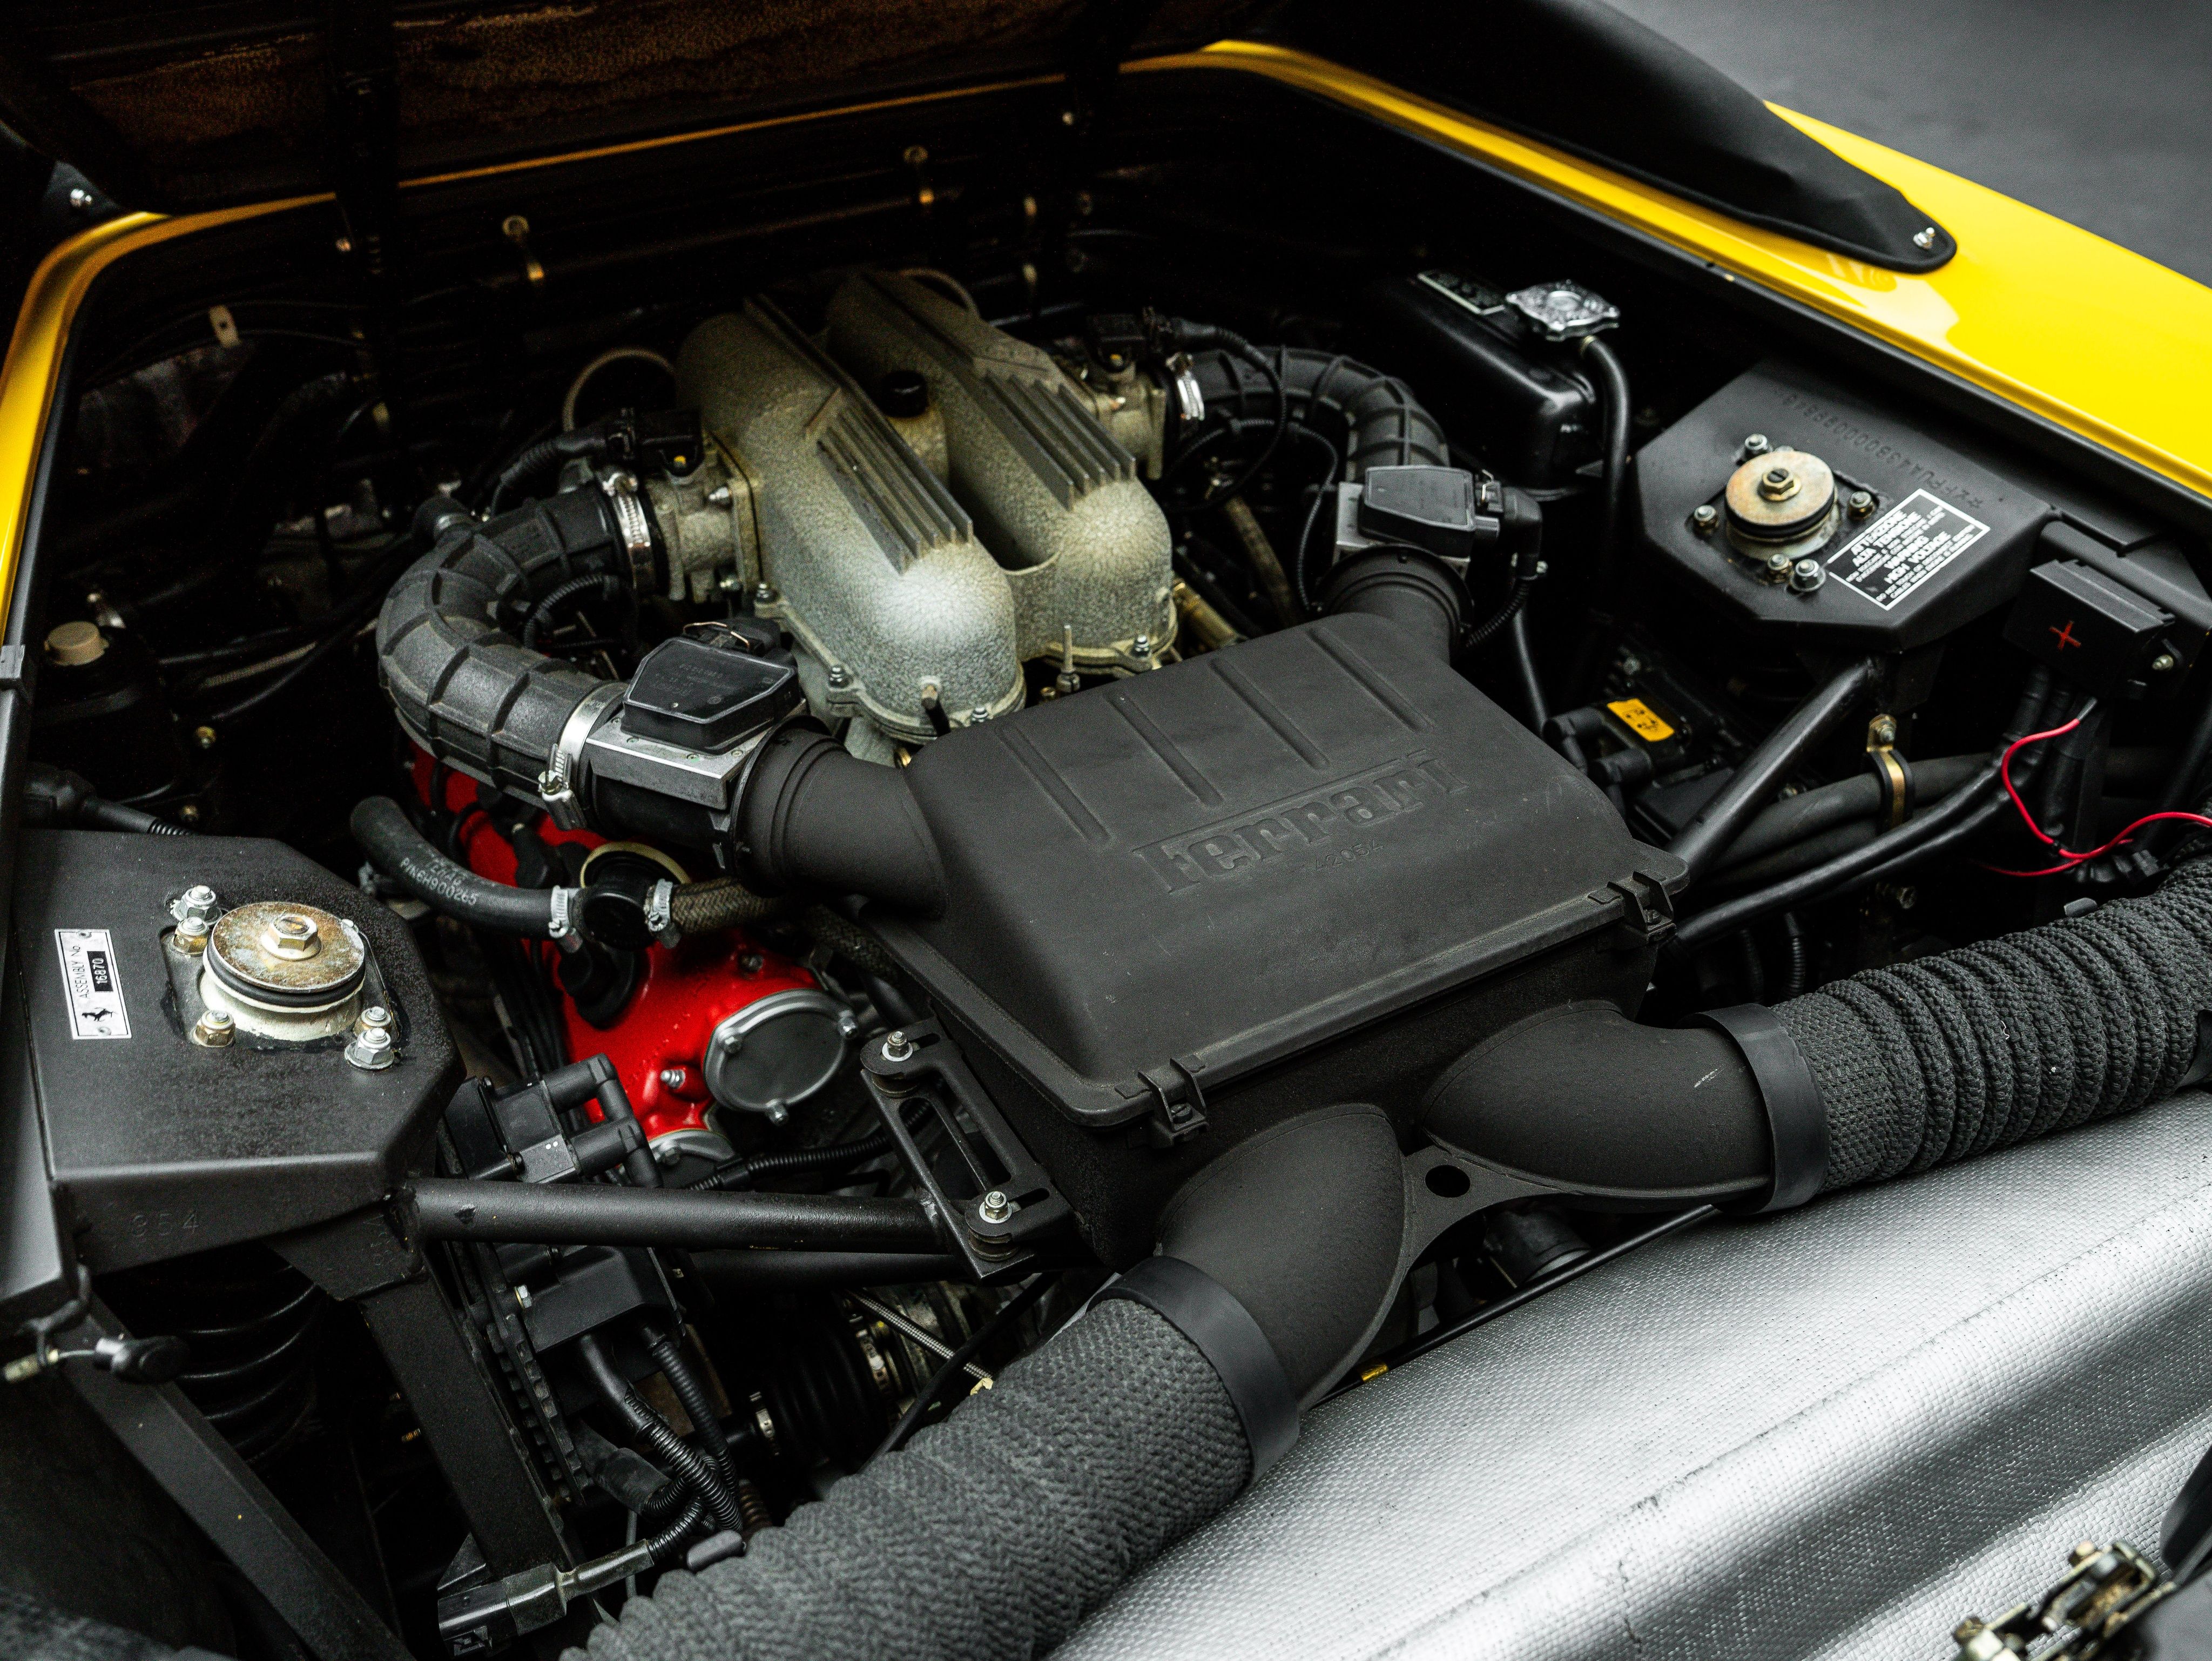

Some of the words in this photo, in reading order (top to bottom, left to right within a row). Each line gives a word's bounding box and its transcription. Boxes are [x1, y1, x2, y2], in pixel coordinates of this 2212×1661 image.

[1851, 510, 1907, 555] ATTENZIONE
[1853, 548, 1876, 567] ALTA
[1873, 512, 1922, 547] TENSIONE
[1884, 535, 1929, 569] WARNING
[1885, 563, 1910, 583] HIGH
[1908, 531, 1951, 563] VOLTAGE
[1132, 750, 1468, 896] Ferrari
[71, 960, 90, 999] ASSEMBLY
[92, 958, 108, 984] 16870
